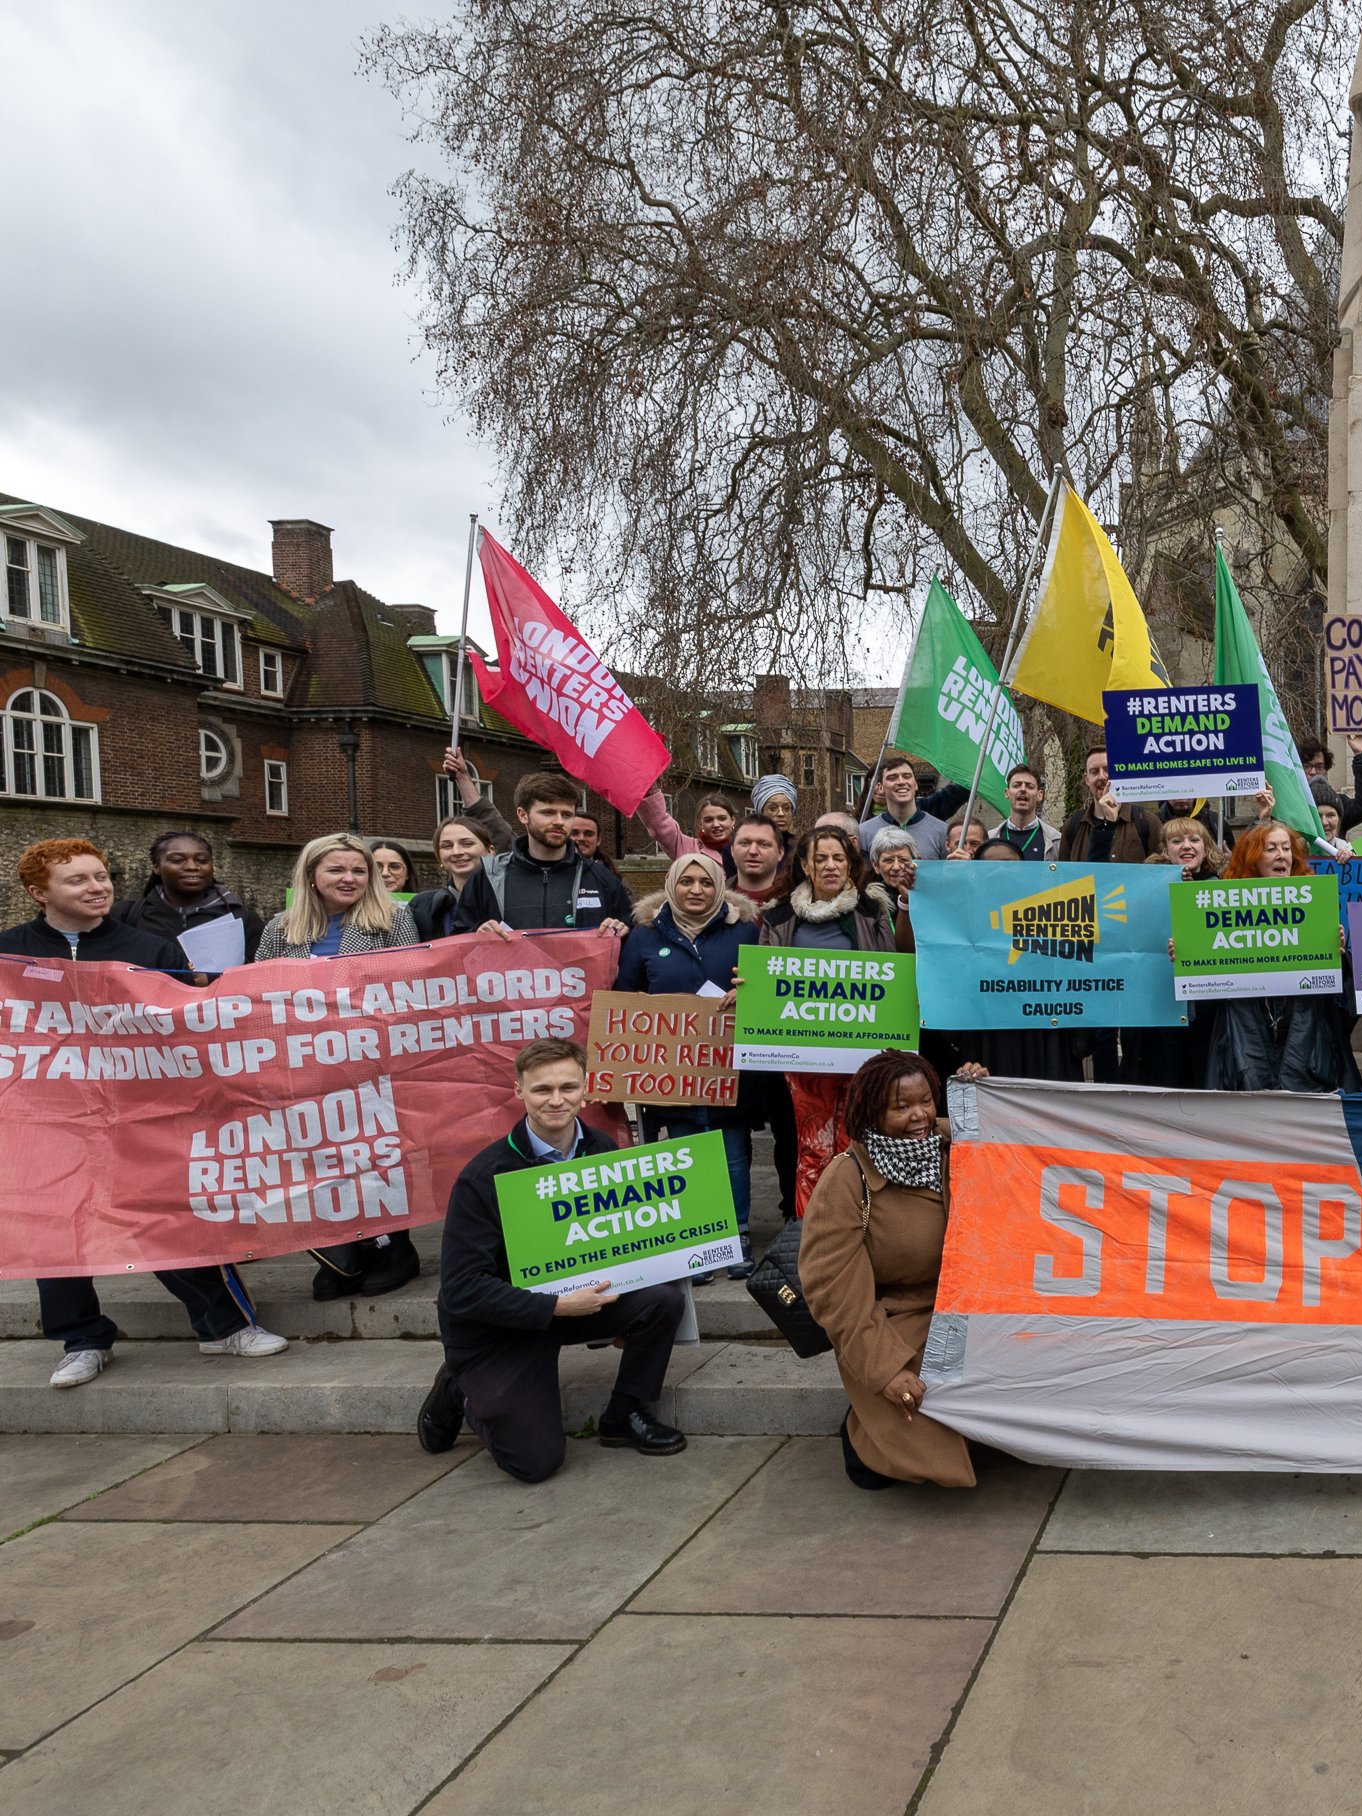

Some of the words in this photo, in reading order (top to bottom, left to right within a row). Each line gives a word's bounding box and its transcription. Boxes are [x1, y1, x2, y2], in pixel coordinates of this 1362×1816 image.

[510, 656, 616, 758] UNION
[1127, 693, 1236, 715] #RENTERS
[1136, 713, 1230, 734] DEMAND
[1144, 733, 1224, 753] ACTION
[1012, 894, 1095, 922] LONDON
[1196, 885, 1312, 908] #RENTERS
[1206, 907, 1305, 928] DEMAND
[1013, 923, 1095, 938] RENTERS
[1212, 928, 1298, 949] ACTION
[1012, 938, 1094, 963] UNION
[1220, 957, 1255, 965] RENTING
[1257, 956, 1279, 964] MORE
[1282, 953, 1333, 962] AFFORDABLE
[768, 956, 895, 981] #RENTERS
[776, 979, 885, 1001] DEMAND
[980, 980, 1063, 992] DISABILITY
[1066, 979, 1124, 991] JUSTICE
[0, 1001, 175, 1036] TANDING
[184, 995, 252, 1032] UP
[262, 989, 327, 1025] TO
[336, 967, 585, 1018] LANDLORDS
[780, 1001, 875, 1022] ACTION
[1023, 1002, 1083, 1016] CAUCUS
[606, 1009, 700, 1036] HONK
[709, 1014, 736, 1037] IF
[757, 1028, 783, 1036] MAKE
[827, 1031, 853, 1039] MORE
[855, 1032, 910, 1040] AFFORDABLE
[208, 1038, 276, 1077] UP
[286, 1028, 379, 1068] FOR
[388, 1007, 574, 1057] RENTERS
[594, 1042, 667, 1065] YOUR
[586, 1071, 613, 1094] IS
[622, 1071, 675, 1096] TOO
[680, 1075, 736, 1104] HIGH
[190, 1074, 399, 1158] LONDON
[189, 1136, 402, 1193] RENTERS
[535, 1147, 693, 1199] #RENTERS
[189, 1167, 409, 1224] UNION
[552, 1174, 687, 1222] DEMAND
[565, 1199, 682, 1246] ACTION
[520, 1266, 540, 1278] TO
[545, 1257, 577, 1273] END
[579, 1249, 607, 1264] THE
[612, 1233, 676, 1257] RENTING
[680, 1219, 729, 1240] CRISIS!
[1033, 1165, 1362, 1307] STOP
